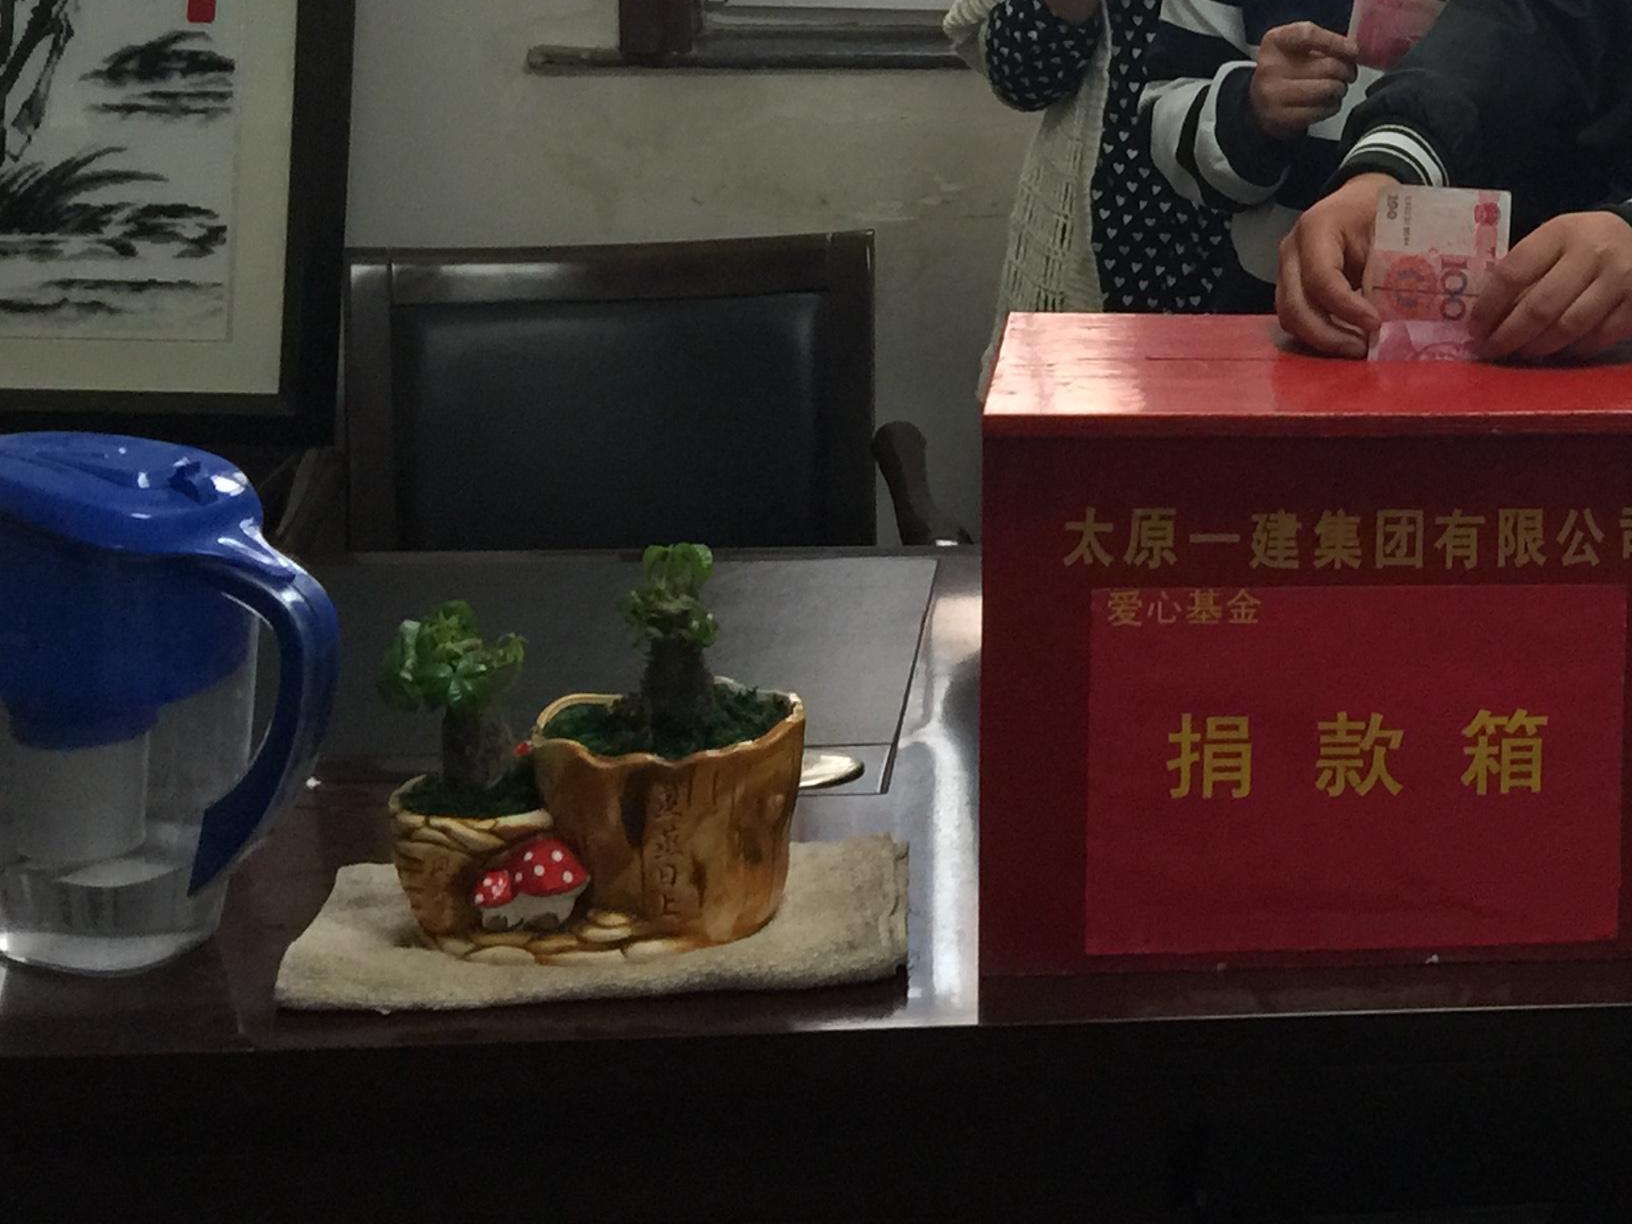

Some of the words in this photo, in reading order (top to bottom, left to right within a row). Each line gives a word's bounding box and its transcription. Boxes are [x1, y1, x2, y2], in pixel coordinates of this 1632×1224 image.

[1439, 256, 1468, 320] 100
[1105, 588, 1262, 627] 爱心基金
[1166, 707, 1549, 799] 捐款箱
